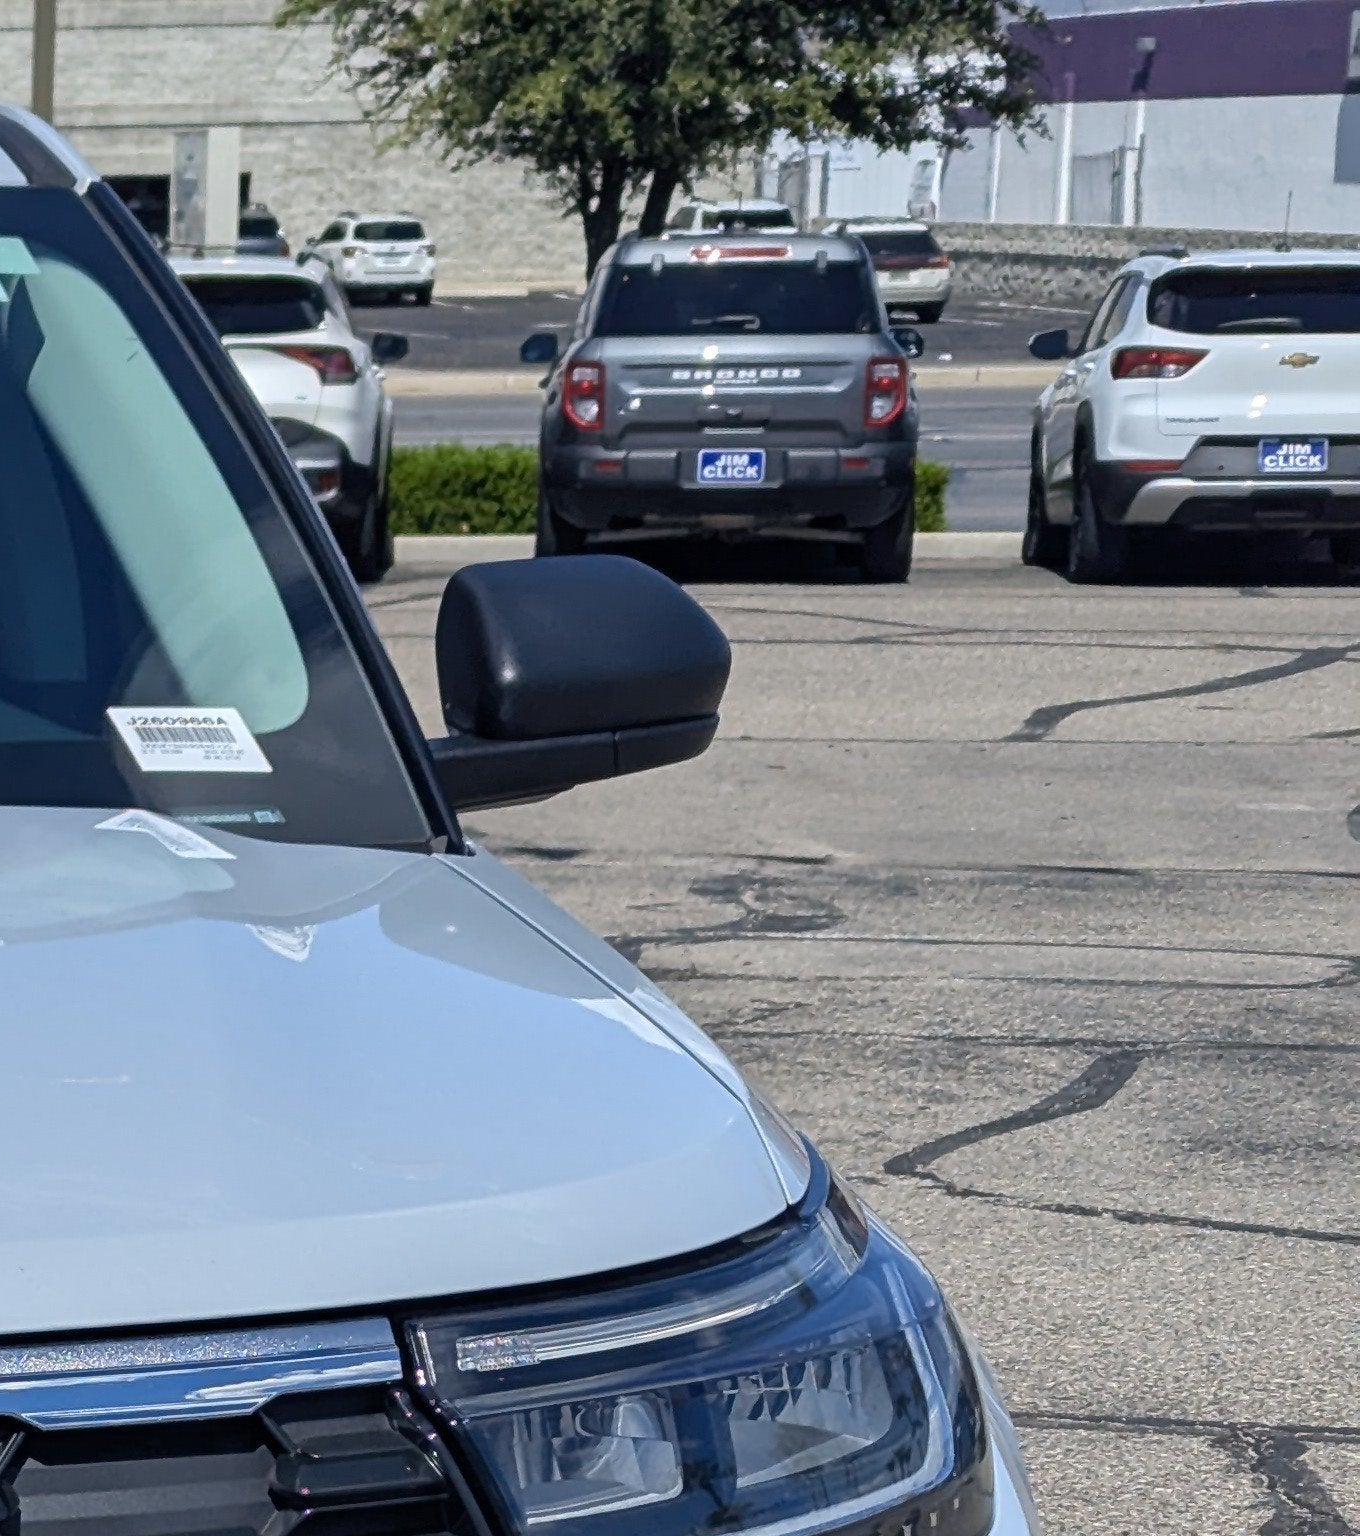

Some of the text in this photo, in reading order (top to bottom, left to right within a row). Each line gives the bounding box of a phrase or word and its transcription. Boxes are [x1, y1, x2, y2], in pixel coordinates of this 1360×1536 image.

[672, 369, 802, 380] BRONCO
[1276, 443, 1312, 455] JIM
[715, 454, 750, 467] JIM
[1264, 454, 1322, 468] CLICK
[702, 465, 759, 479] CLICK
